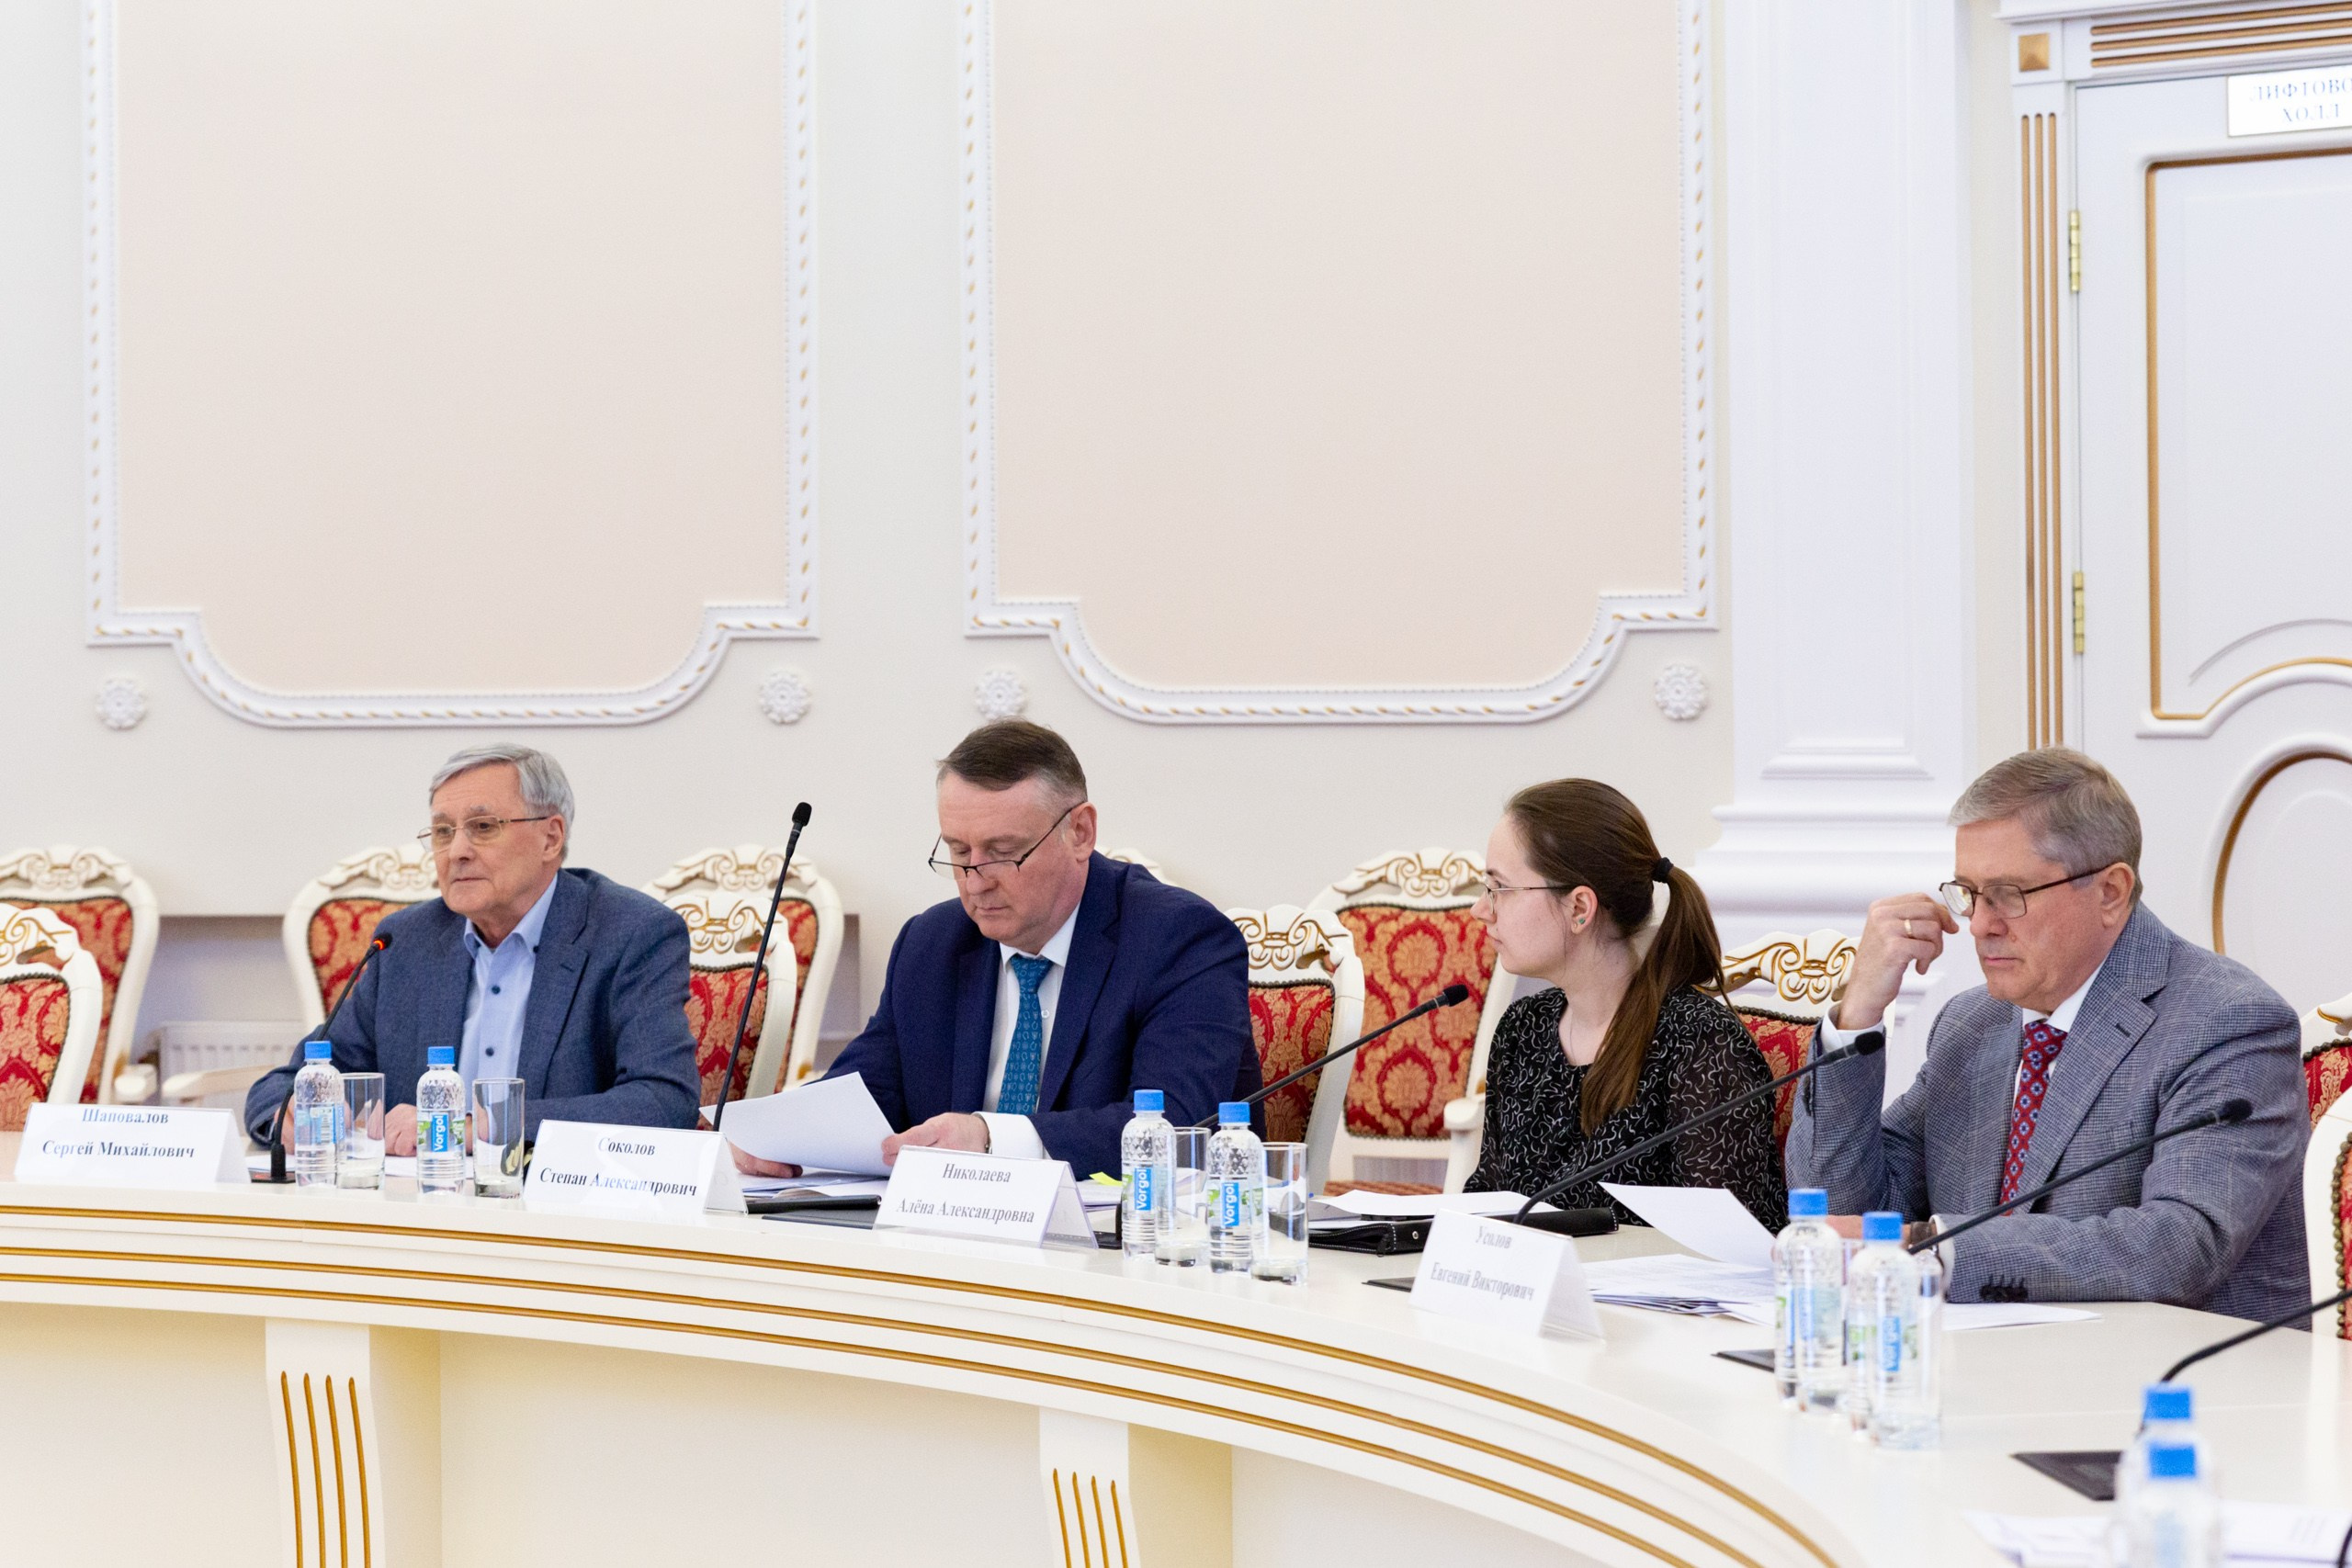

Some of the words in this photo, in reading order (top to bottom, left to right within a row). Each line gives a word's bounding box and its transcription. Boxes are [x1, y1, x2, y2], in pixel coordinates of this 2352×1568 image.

[82, 1108, 169, 1124] Шаповалов
[434, 1114, 446, 1152] Vorgol
[598, 1136, 656, 1156] Соколов
[42, 1139, 94, 1158] Сергей
[97, 1141, 195, 1158] Михайлович
[539, 1167, 588, 1186] Степан
[590, 1172, 697, 1197] Александрович
[942, 1162, 1012, 1183] Николаева
[1136, 1168, 1148, 1211] Vorgol
[1223, 1182, 1237, 1225] Vorgol
[896, 1198, 934, 1215] Алёна
[937, 1201, 1035, 1225] Александровна
[1430, 1261, 1472, 1287] Евгений
[1471, 1269, 1535, 1301] Викторович
